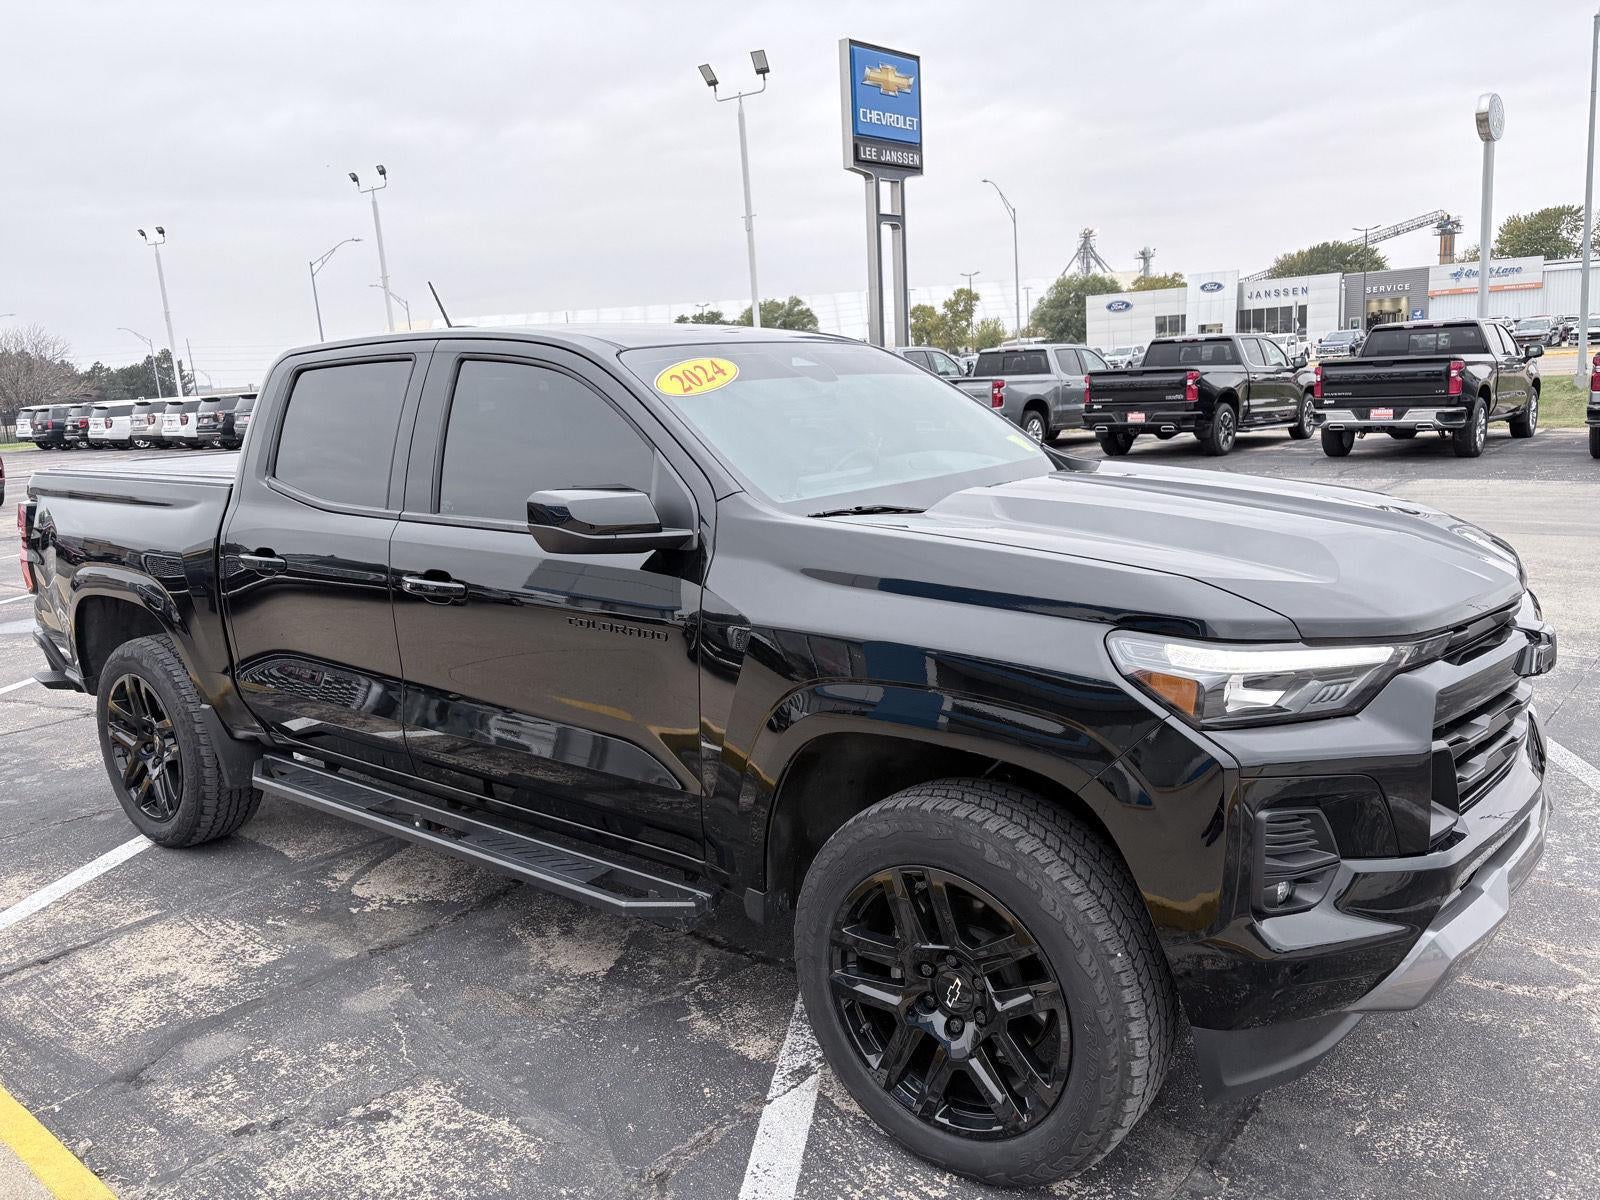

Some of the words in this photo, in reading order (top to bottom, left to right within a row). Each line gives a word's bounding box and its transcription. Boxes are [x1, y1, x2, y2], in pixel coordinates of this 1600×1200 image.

[860, 108, 918, 130] CHEVROLET
[861, 146, 877, 160] LEE
[881, 150, 920, 165] JANSSEN
[1496, 266, 1523, 275] Lane
[1247, 286, 1308, 299] JANSSEN
[1366, 283, 1410, 293] SERVICE
[670, 360, 727, 393] 2024
[566, 617, 669, 642] COLORADO
